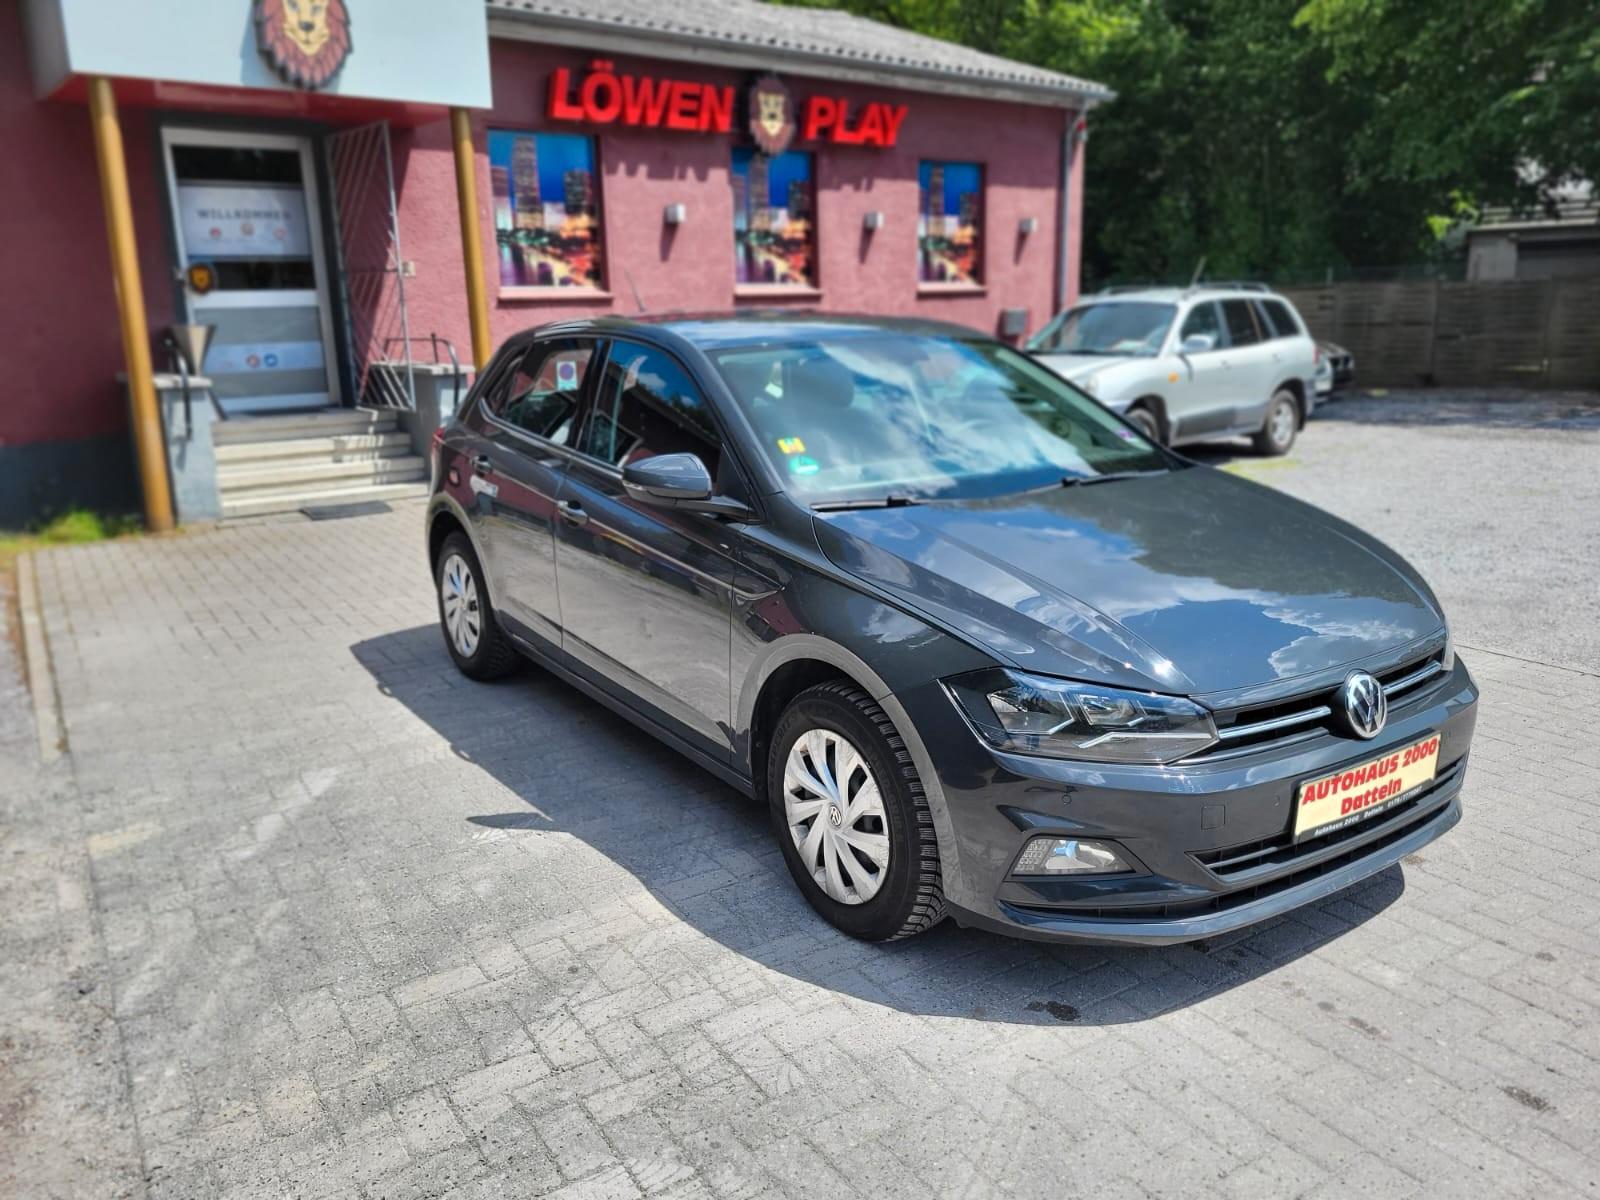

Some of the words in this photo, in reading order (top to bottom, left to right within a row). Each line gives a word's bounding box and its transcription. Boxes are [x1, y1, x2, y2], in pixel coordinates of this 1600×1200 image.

[551, 60, 735, 133] LÖWEN
[805, 95, 908, 147] PLAY
[1302, 754, 1399, 806] AUTOHAUS
[1402, 738, 1438, 767] 2000
